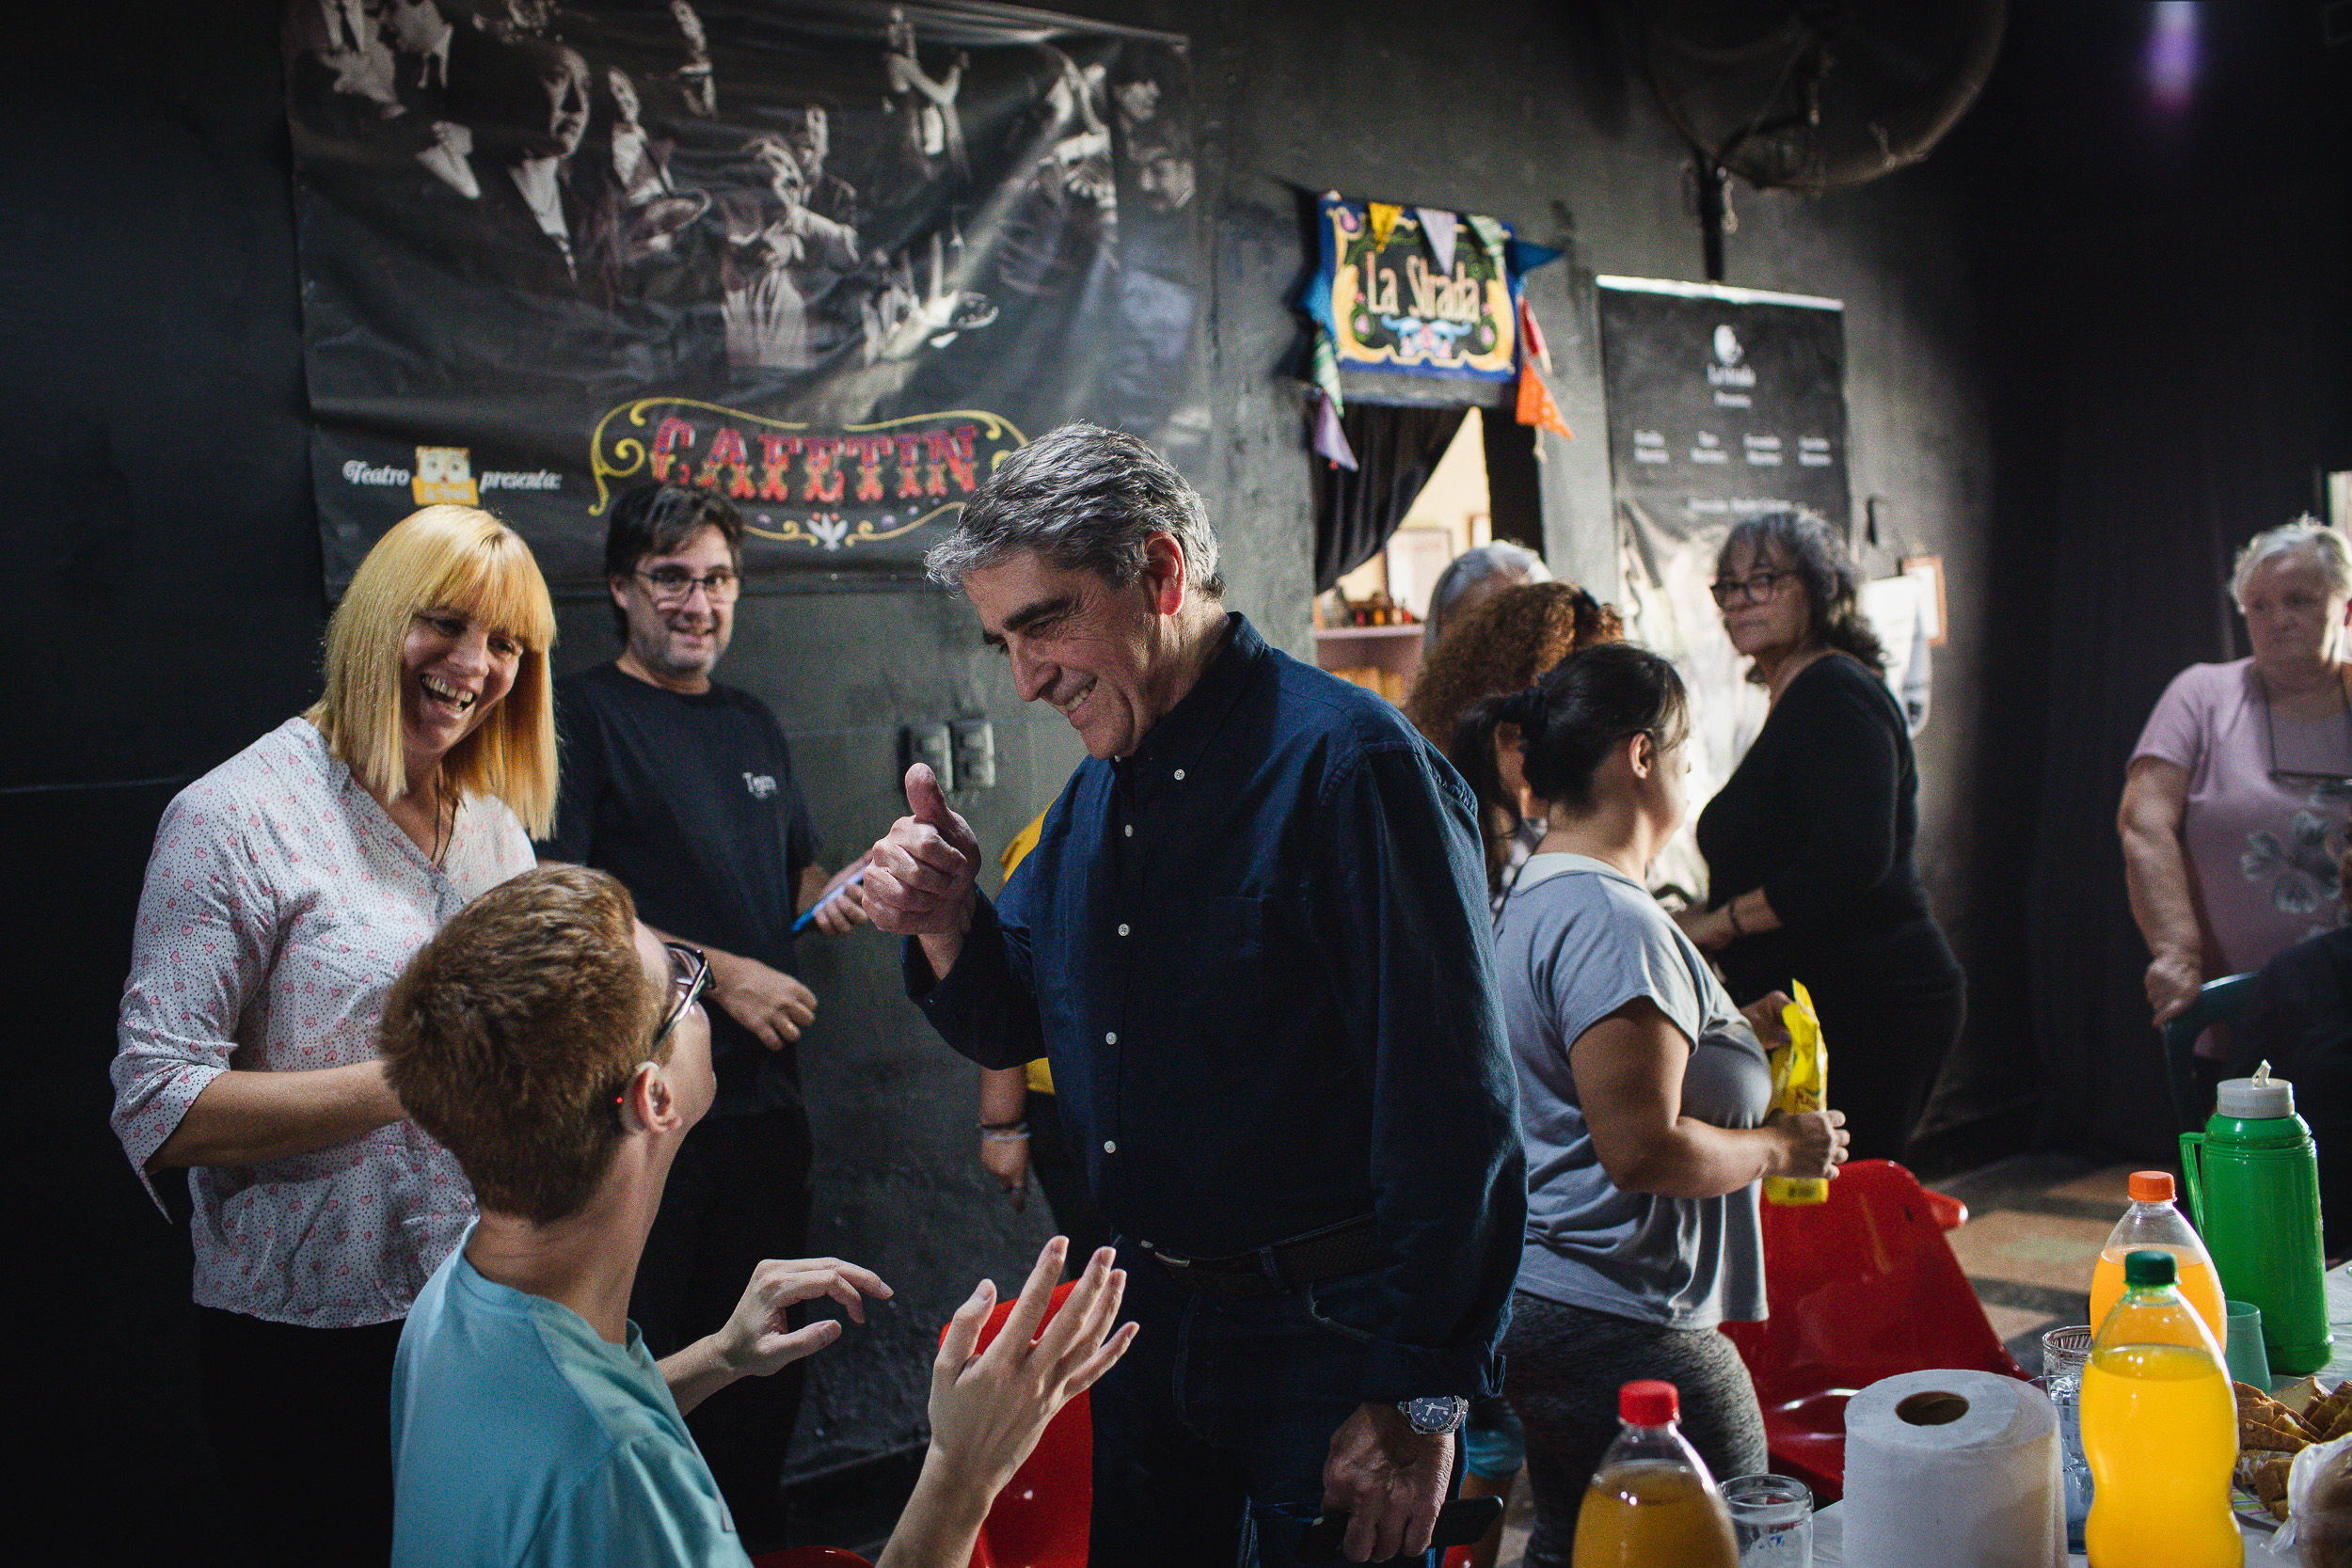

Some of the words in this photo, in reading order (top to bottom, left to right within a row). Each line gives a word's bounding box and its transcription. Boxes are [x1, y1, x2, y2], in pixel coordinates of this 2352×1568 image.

[1366, 251, 1400, 316] La
[1406, 254, 1481, 324] Strada
[342, 459, 411, 487] Teatro
[648, 415, 979, 503] CAFETIN
